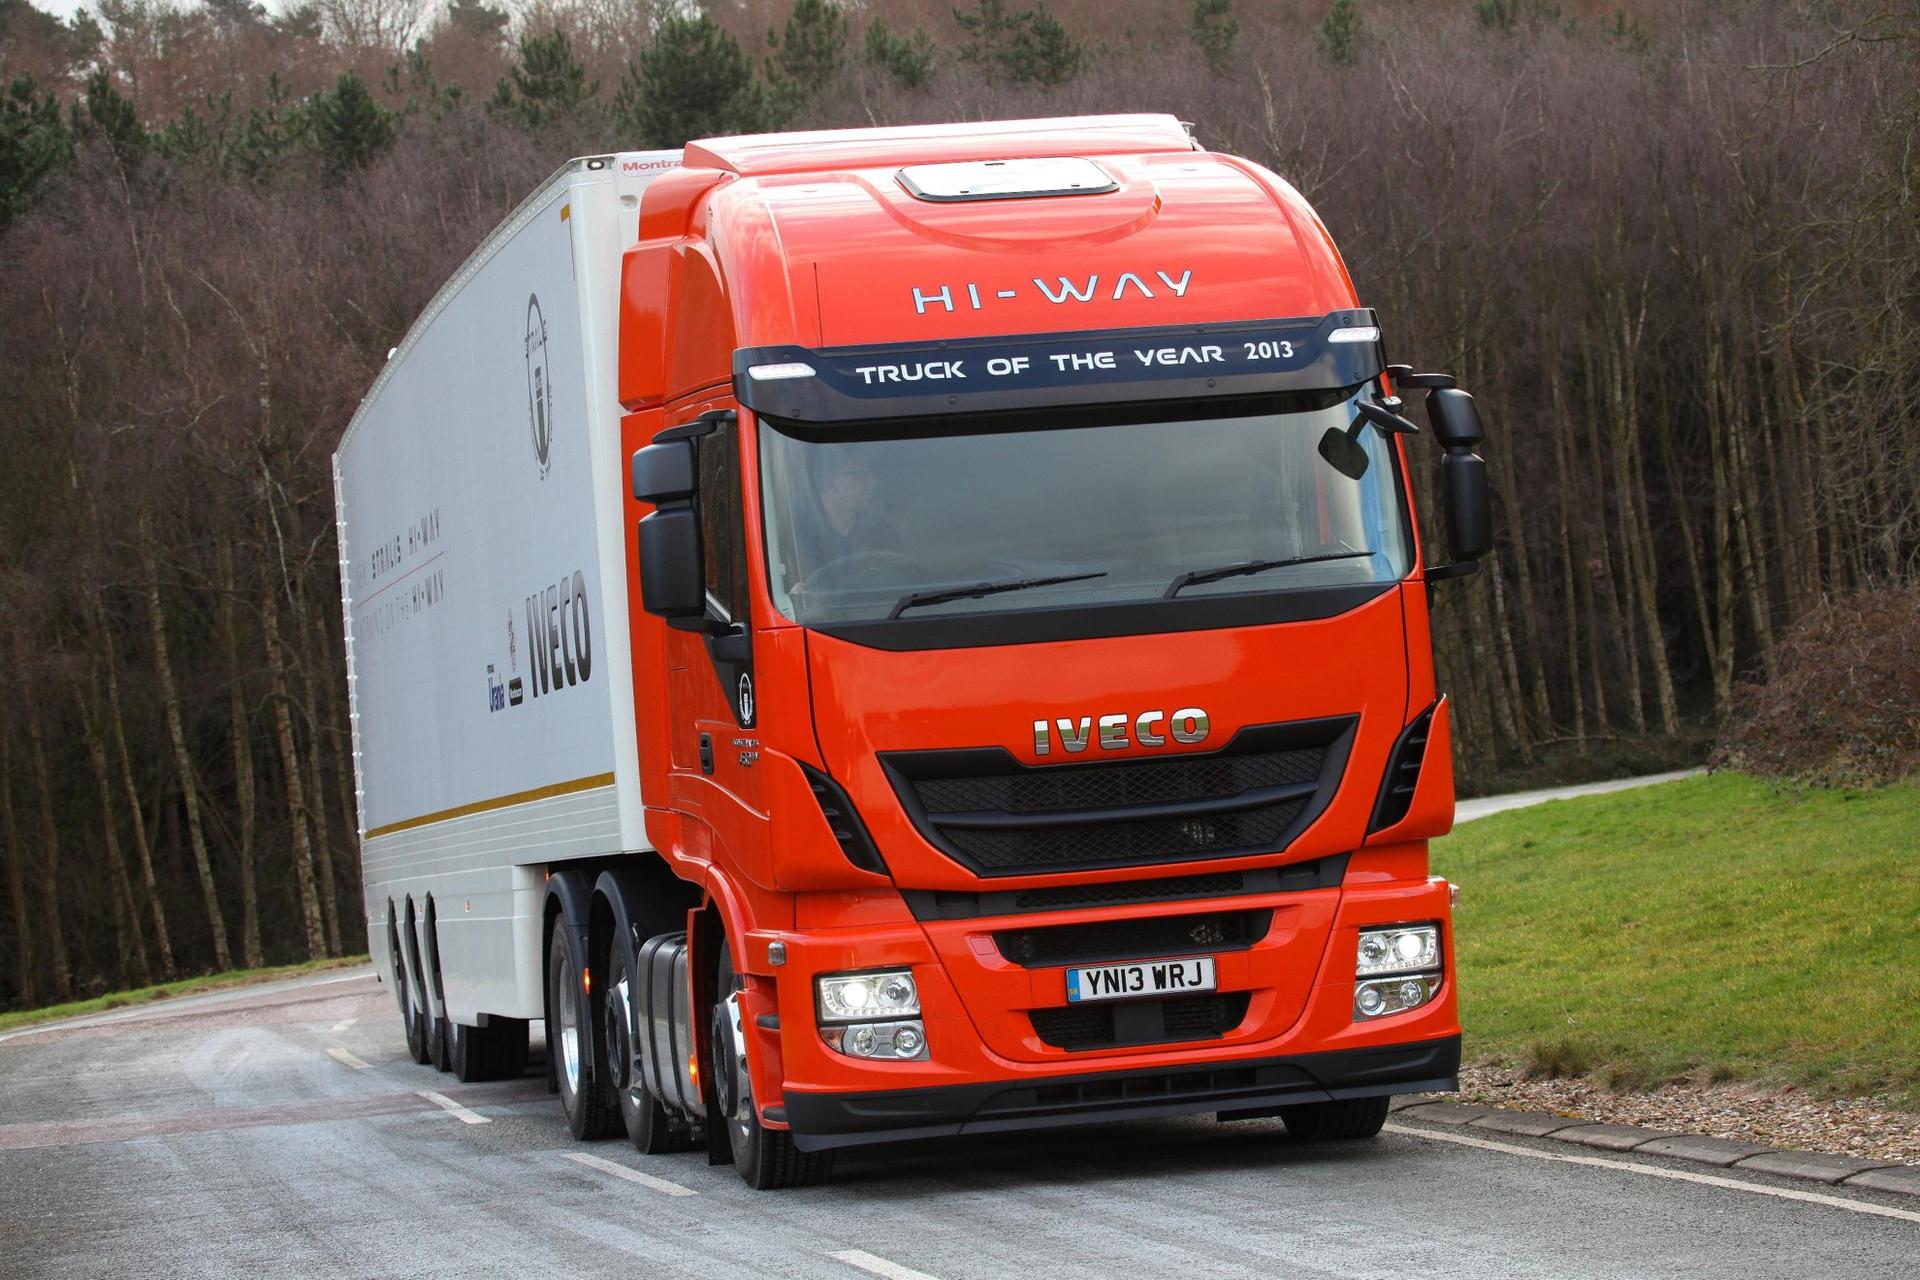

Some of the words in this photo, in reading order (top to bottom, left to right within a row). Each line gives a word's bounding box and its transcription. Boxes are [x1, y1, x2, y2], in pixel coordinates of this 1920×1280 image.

[856, 360, 967, 384] TRUCK
[986, 356, 1030, 376] OF
[1049, 351, 1116, 371] THE
[1134, 345, 1225, 367] YEAR
[1243, 340, 1294, 360] 2013
[526, 570, 592, 698] IVECO
[1033, 707, 1211, 756] IVECO
[1086, 967, 1144, 995] YN13
[1152, 961, 1203, 990] WRJ
